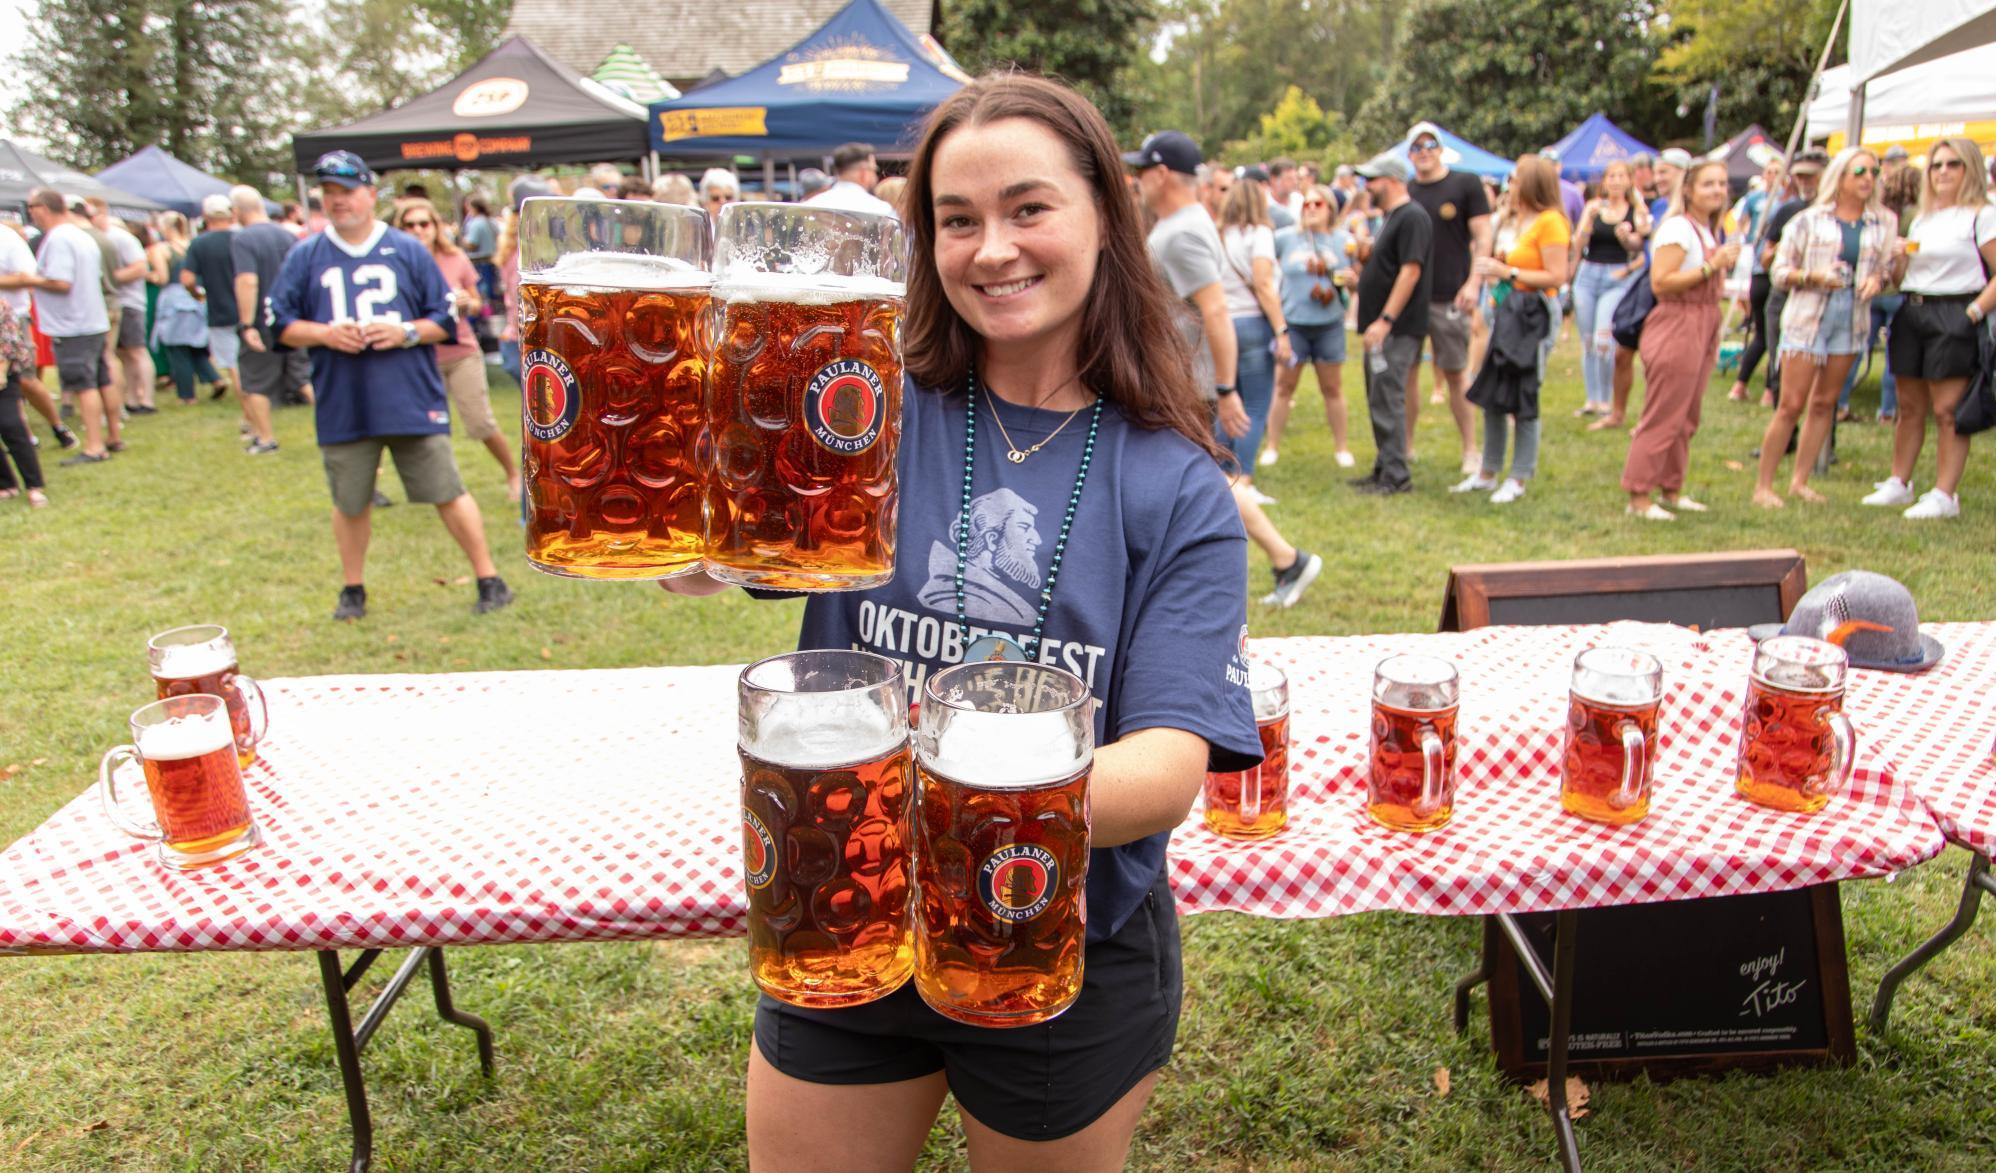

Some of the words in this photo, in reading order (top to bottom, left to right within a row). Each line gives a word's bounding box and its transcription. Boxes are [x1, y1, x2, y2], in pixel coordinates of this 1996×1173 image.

[320, 264, 401, 326] 12
[809, 362, 883, 398] PAULANER
[815, 426, 877, 451] MÜNCHEN
[859, 600, 1105, 688] OKTOBFEST
[983, 846, 1055, 875] PAULANER
[1740, 946, 1784, 982] enjoy!
